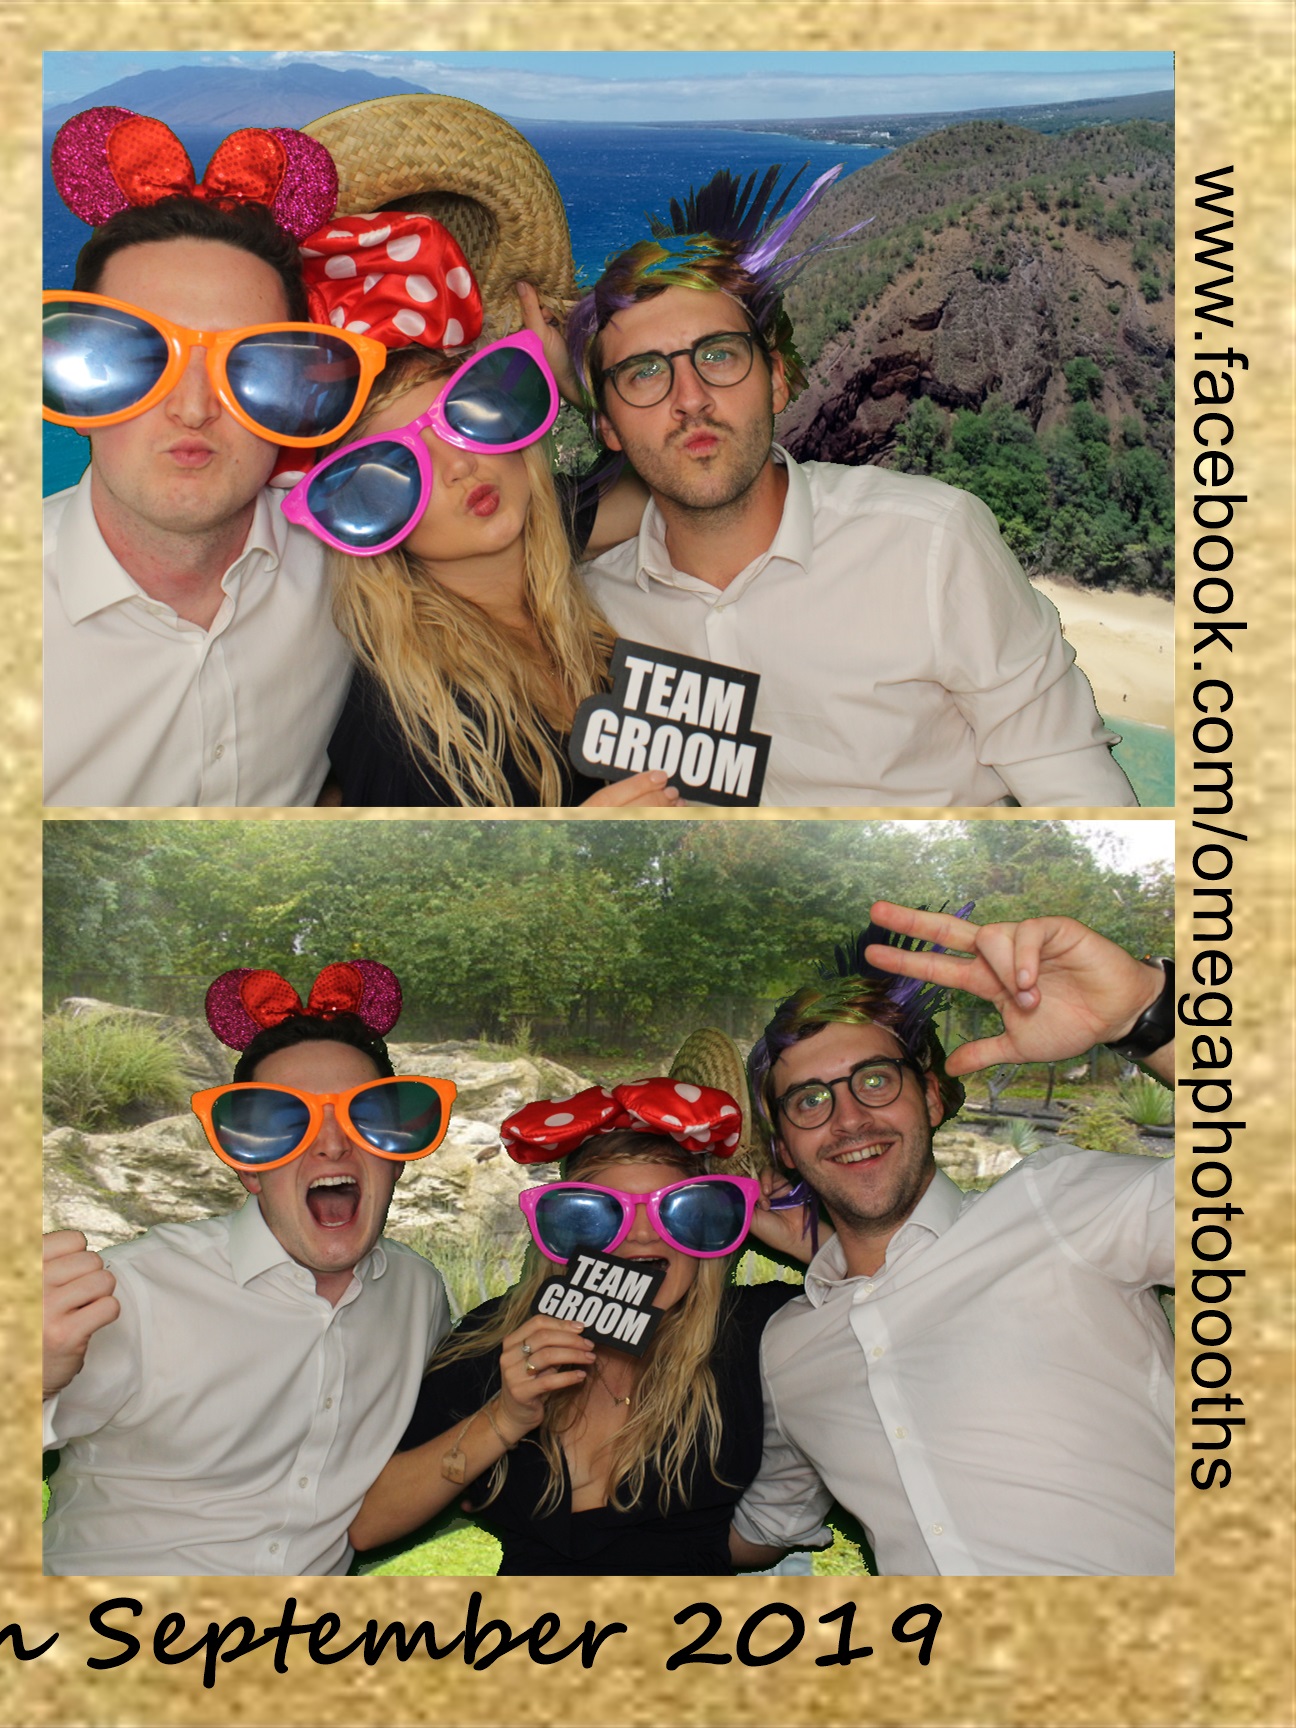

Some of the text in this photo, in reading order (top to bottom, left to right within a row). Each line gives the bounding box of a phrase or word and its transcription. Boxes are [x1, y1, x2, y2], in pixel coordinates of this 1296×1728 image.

[623, 655, 746, 735] TEAM
[582, 708, 757, 798] GROOM
[537, 1283, 652, 1346] GROOM
[570, 1254, 654, 1307] TEAM
